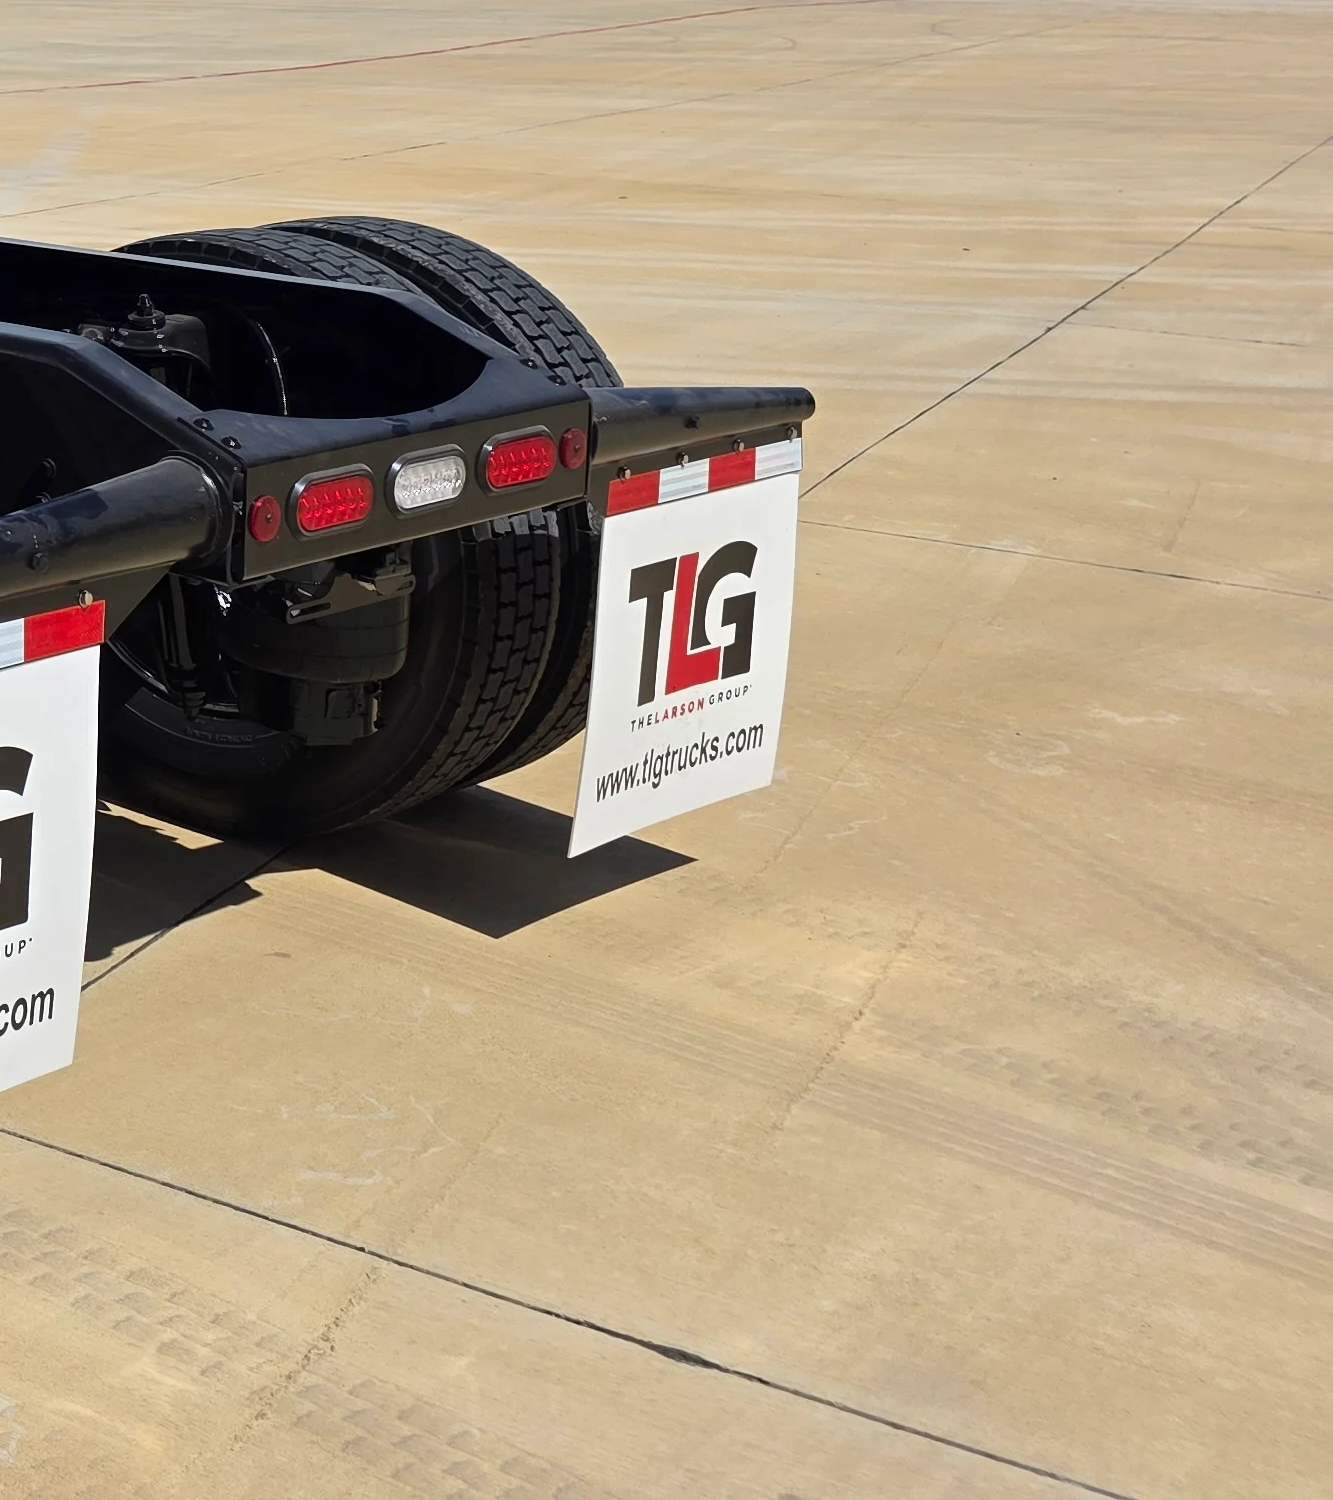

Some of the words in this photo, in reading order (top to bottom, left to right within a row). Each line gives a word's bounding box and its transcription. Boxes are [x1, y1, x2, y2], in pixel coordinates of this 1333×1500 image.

[629, 541, 758, 707] TLG
[708, 686, 749, 705] GROUP
[595, 722, 764, 803] www.tlgtrucks.com
